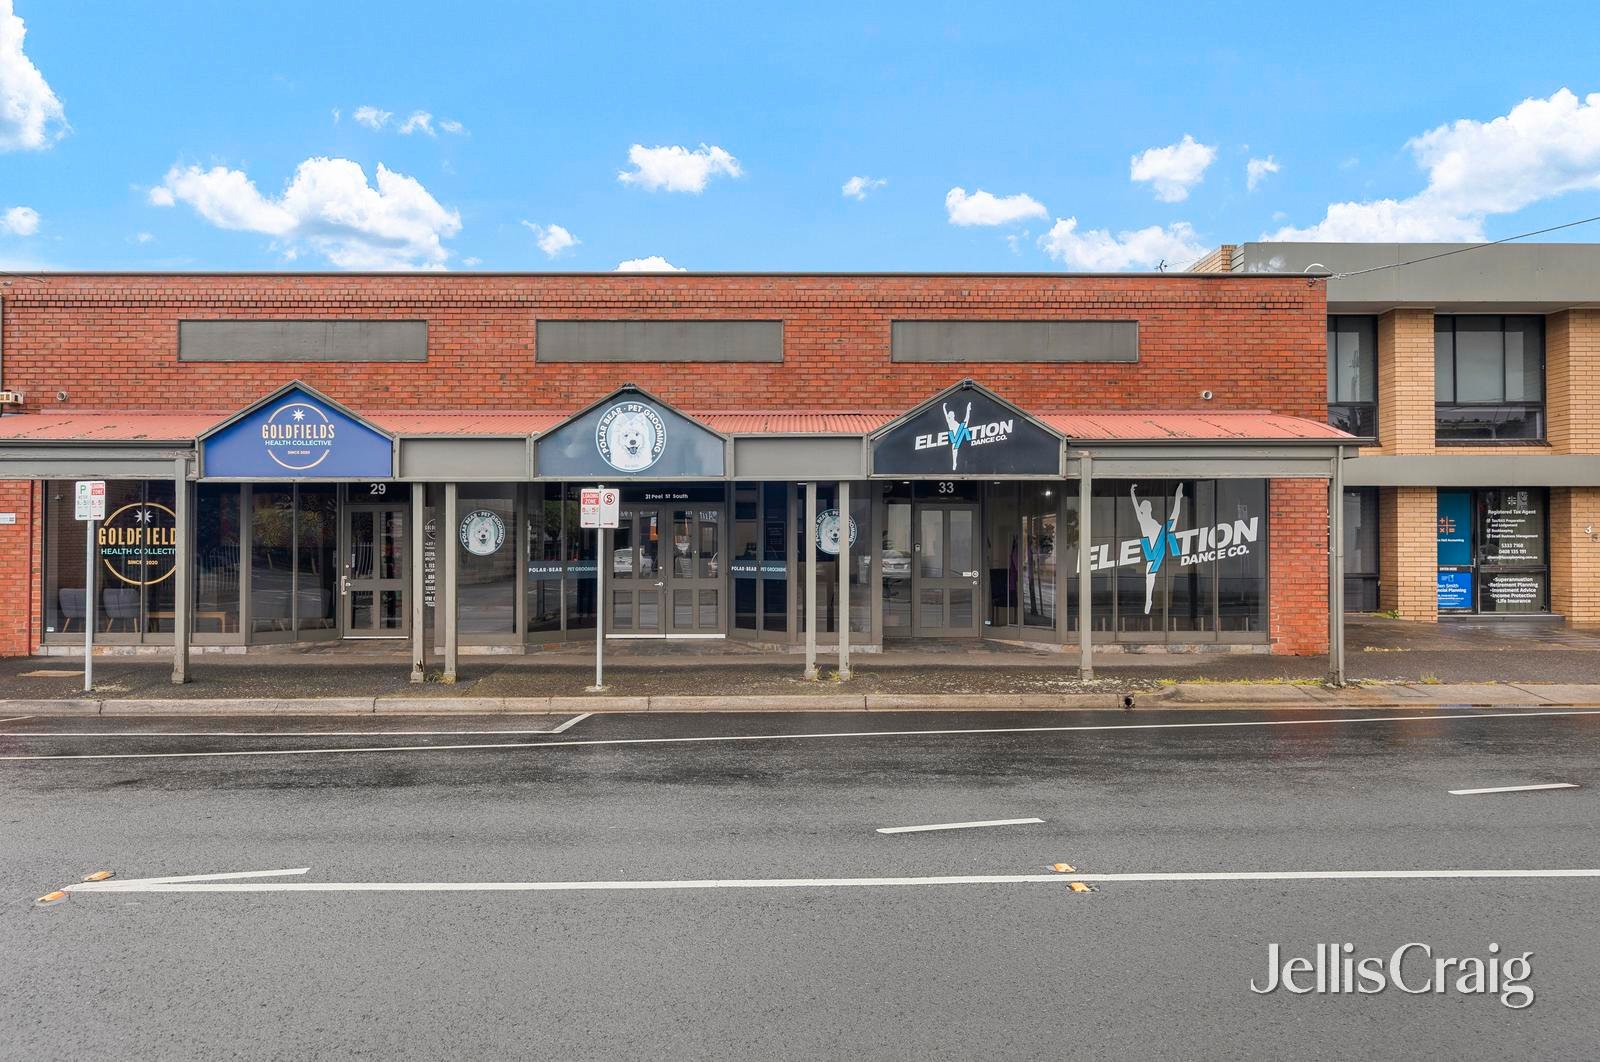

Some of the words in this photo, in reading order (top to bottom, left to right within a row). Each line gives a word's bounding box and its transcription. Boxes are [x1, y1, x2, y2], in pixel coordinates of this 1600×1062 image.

[627, 404, 643, 412] PET
[603, 407, 623, 425] BEAR
[262, 424, 335, 438] GOLDFIELDS
[643, 409, 664, 453] GROOMING
[914, 419, 1014, 450] ELEVATION
[599, 425, 610, 454] POLAR
[970, 436, 996, 446] DANCE
[80, 485, 86, 494] P
[370, 483, 386, 494] 29
[938, 482, 954, 494] 33
[1180, 548, 1227, 566] DANCE
[1228, 544, 1250, 557] CO.
